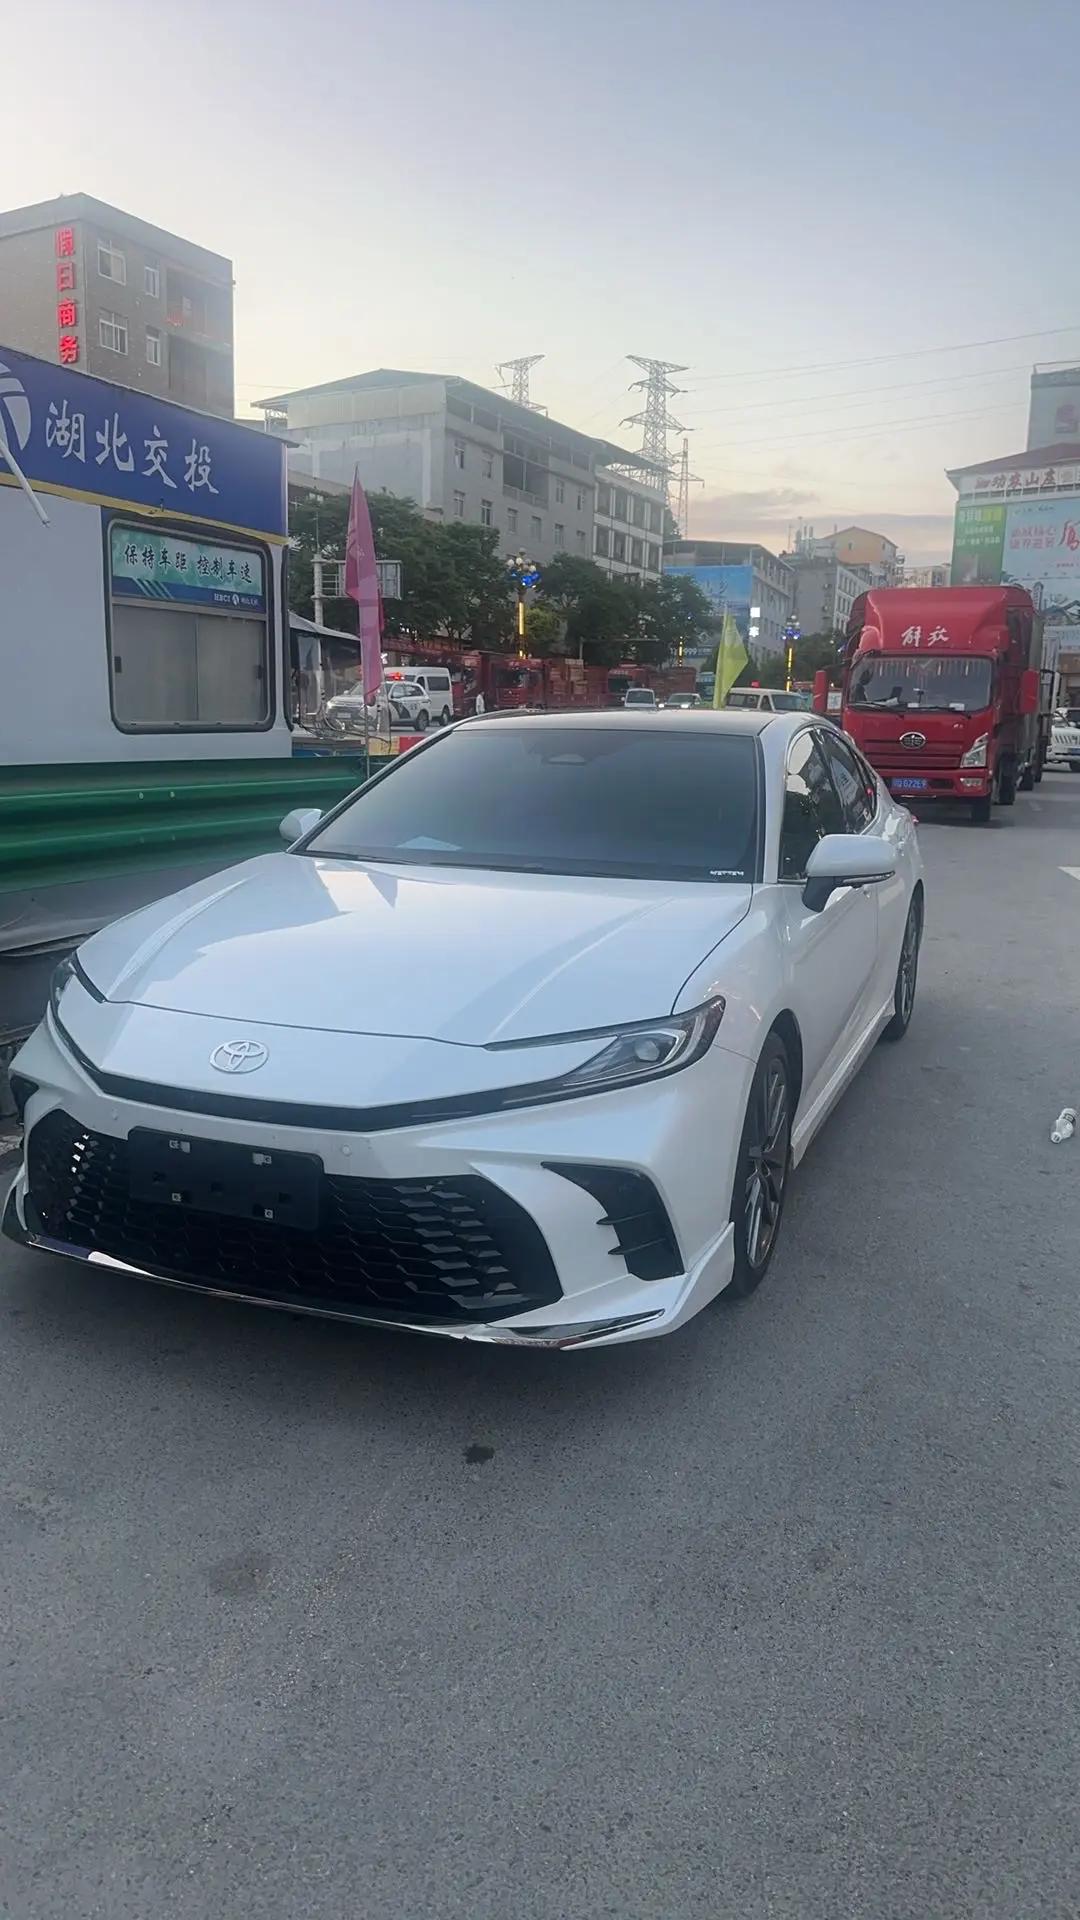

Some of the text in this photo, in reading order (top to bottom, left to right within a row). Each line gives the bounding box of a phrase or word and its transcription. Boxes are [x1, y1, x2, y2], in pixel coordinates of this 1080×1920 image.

[45, 400, 220, 495] 湖北交投
[124, 544, 253, 584] 保持车距 控制车速
[901, 625, 950, 647] 解放
